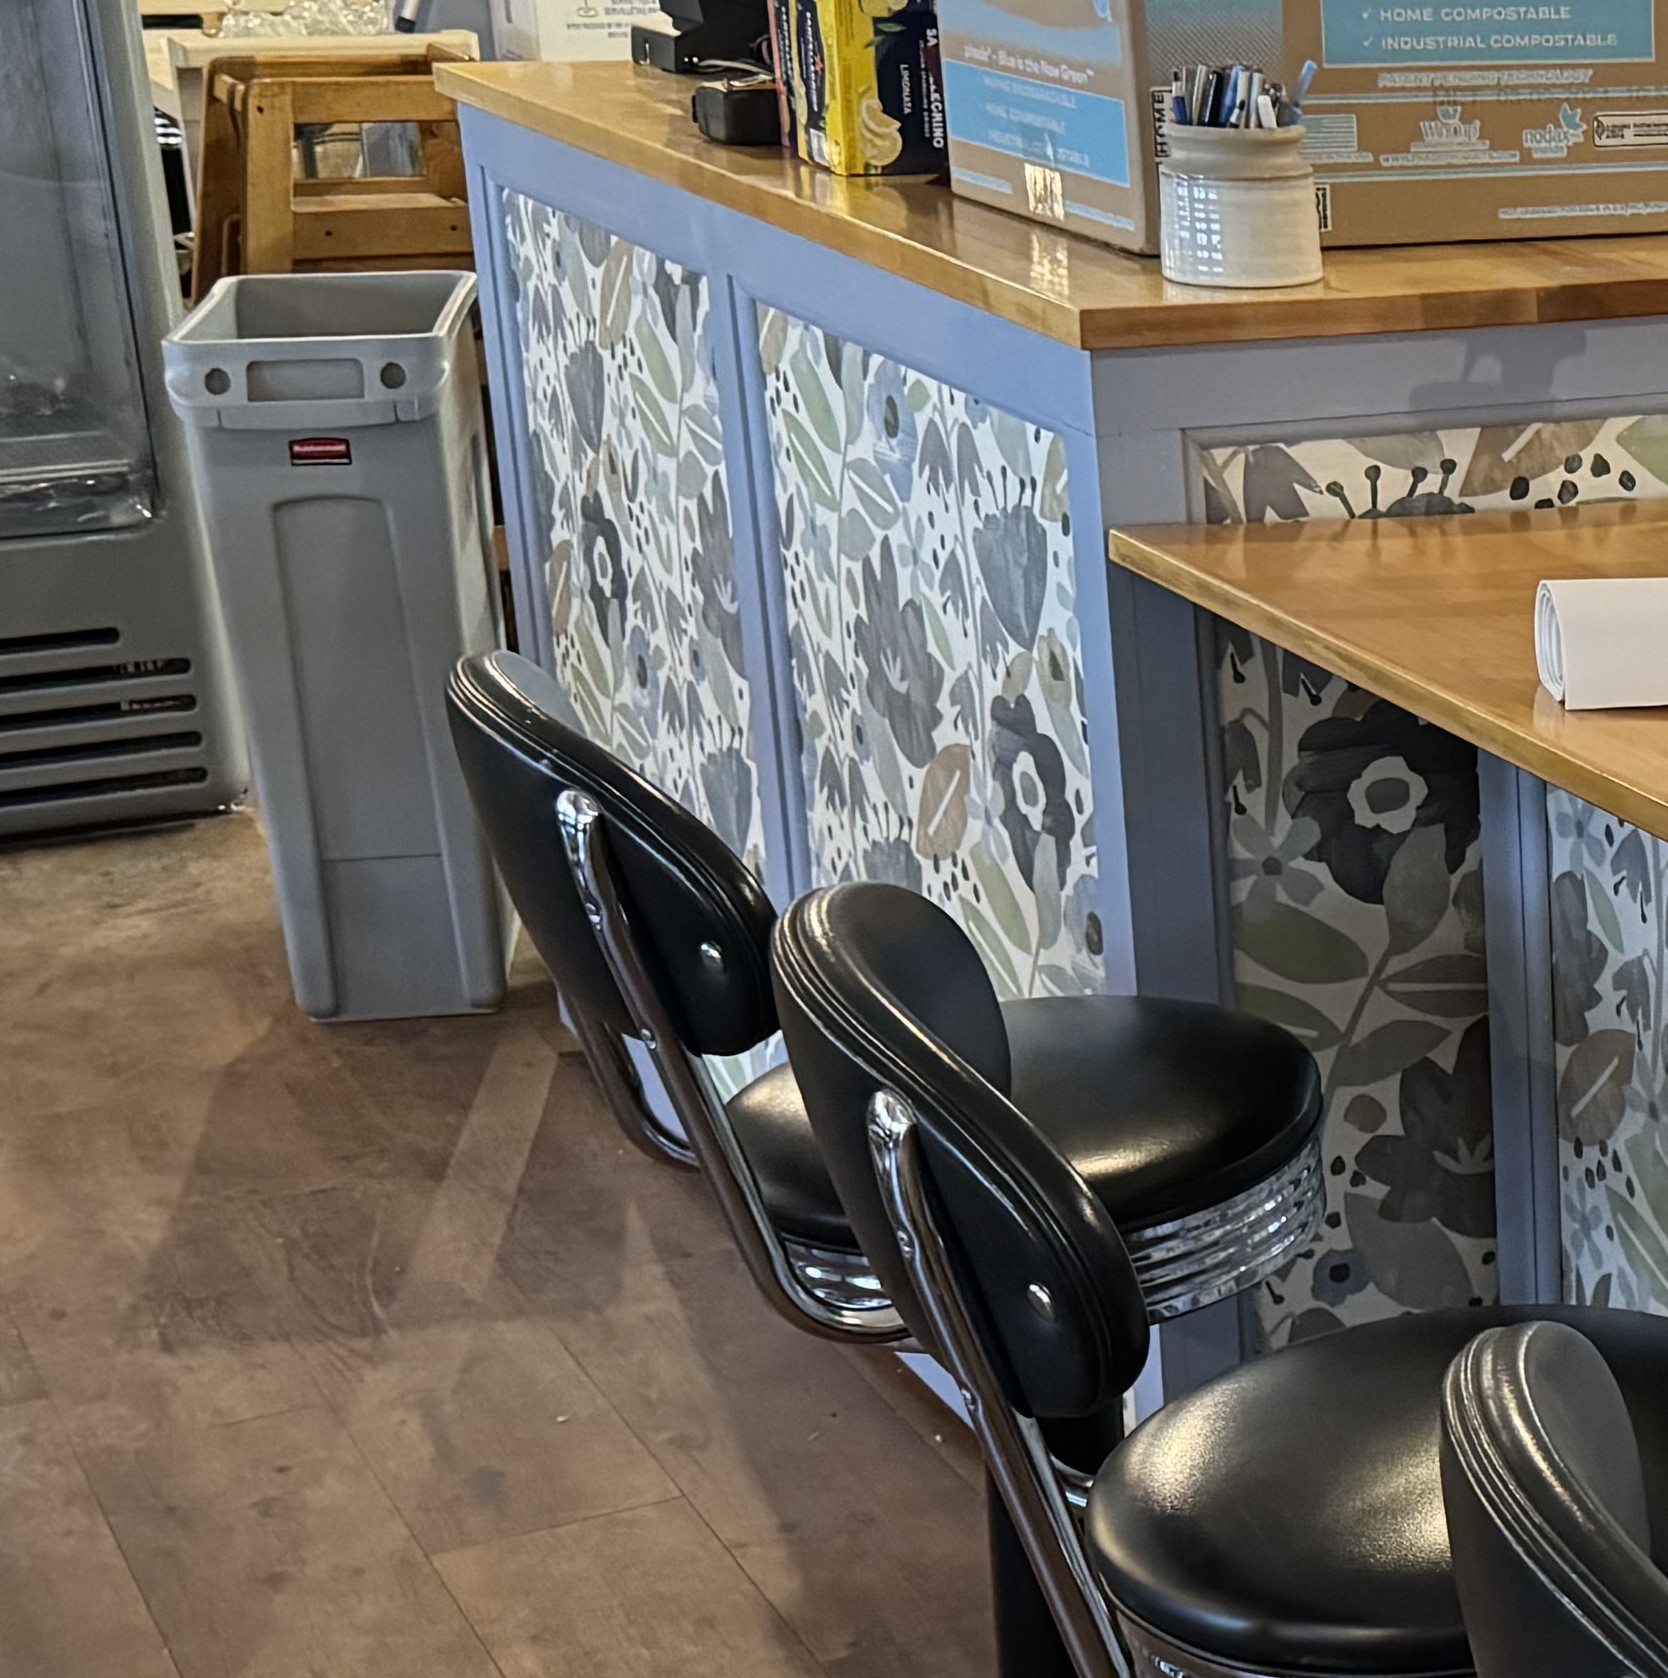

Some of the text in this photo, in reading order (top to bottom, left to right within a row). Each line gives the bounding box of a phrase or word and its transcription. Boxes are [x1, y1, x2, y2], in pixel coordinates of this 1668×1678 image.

[1381, 6, 1572, 21] HOME COMPOSTABLE
[1382, 34, 1618, 50] INDUSTRIAL COMPOSTABLE
